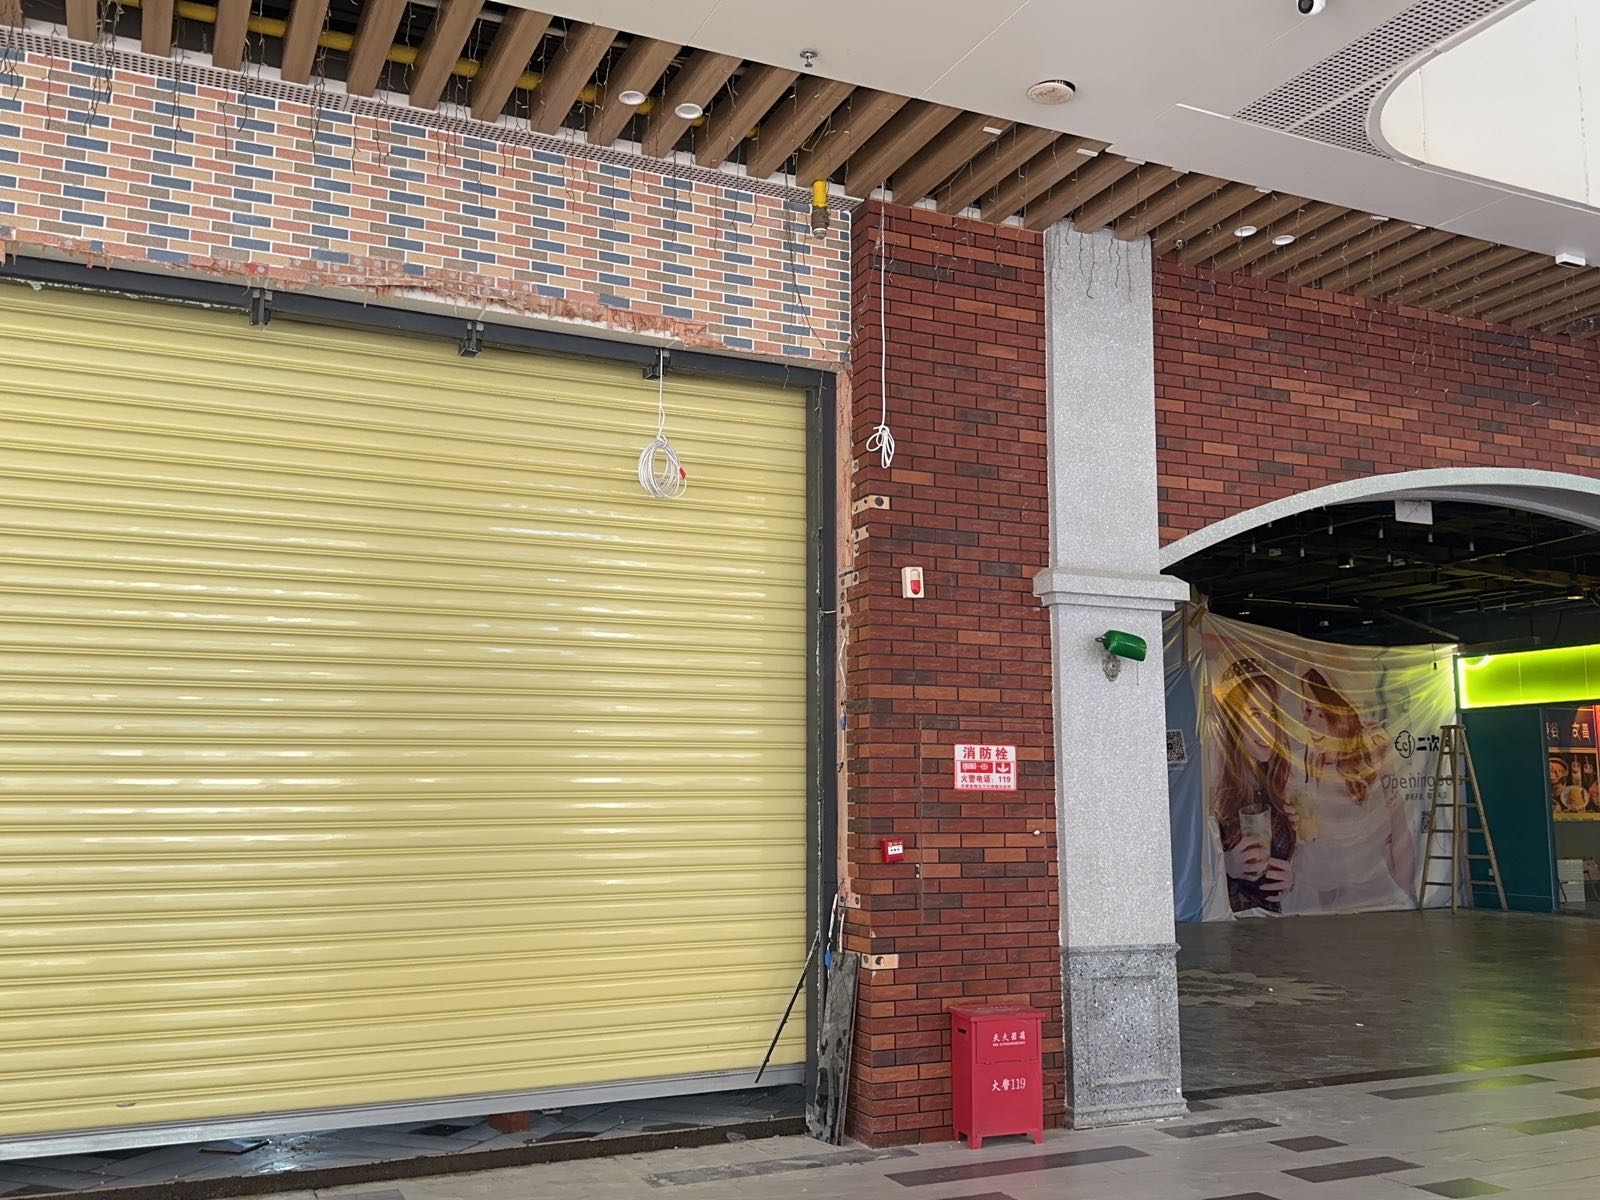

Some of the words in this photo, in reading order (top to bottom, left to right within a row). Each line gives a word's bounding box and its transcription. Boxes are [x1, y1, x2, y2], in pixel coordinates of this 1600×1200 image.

[962, 746, 1008, 760] 消防栓
[1381, 772, 1435, 792] Opening
[992, 1078, 1026, 1092] 火警119
